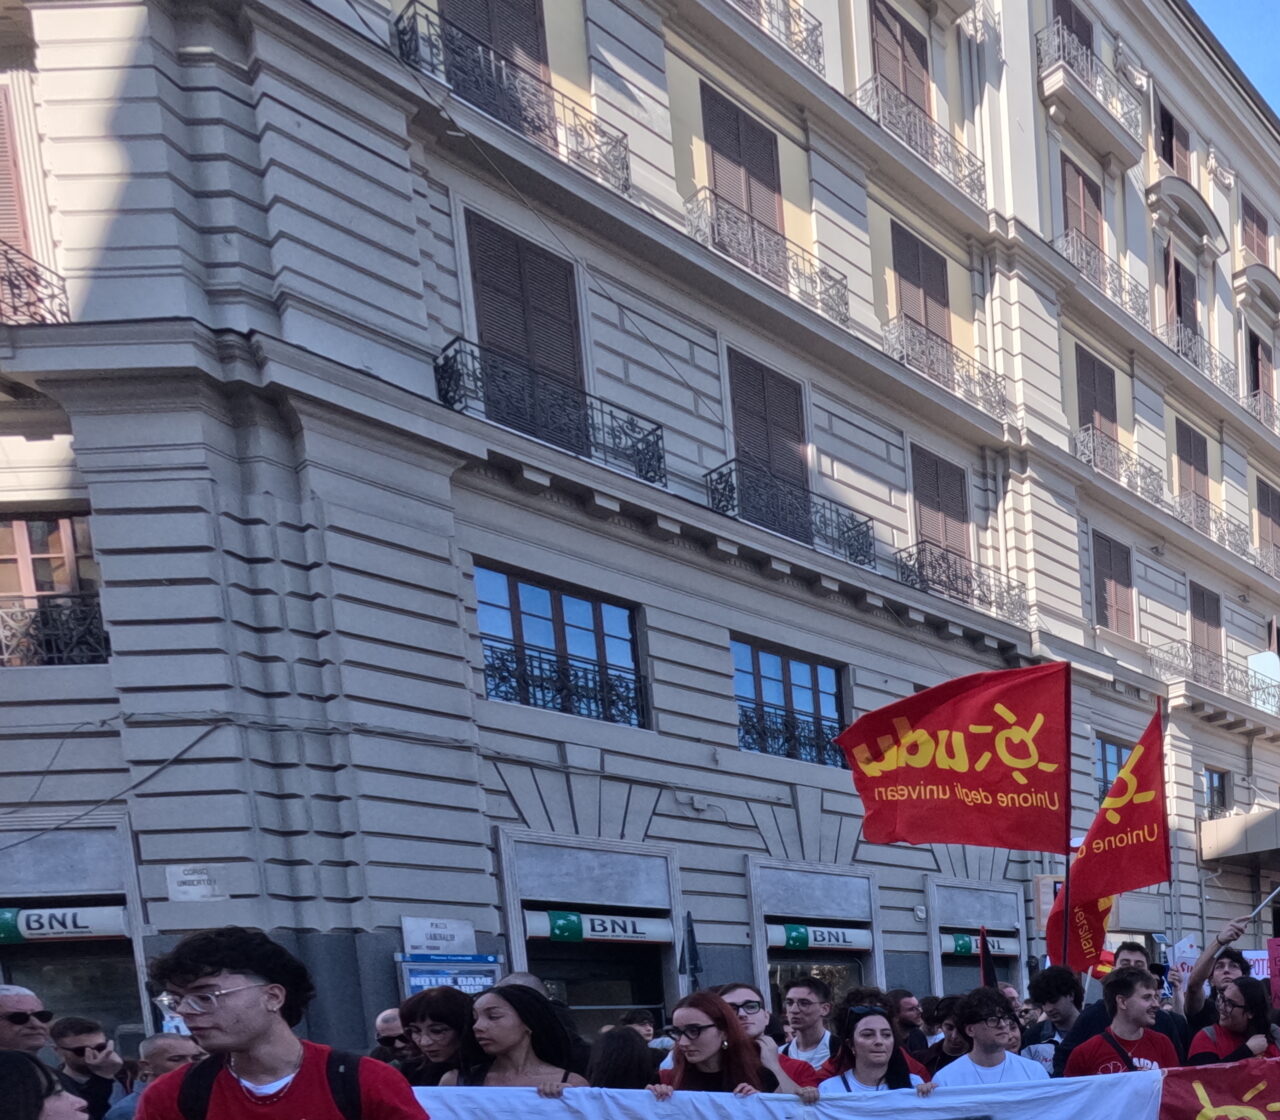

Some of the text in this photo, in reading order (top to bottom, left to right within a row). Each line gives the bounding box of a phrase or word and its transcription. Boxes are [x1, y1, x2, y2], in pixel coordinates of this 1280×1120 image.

[25, 911, 90, 931] BNL
[589, 918, 647, 936] BNL
[812, 929, 853, 944] BNL
[410, 976, 494, 986] NOTRE DAME
